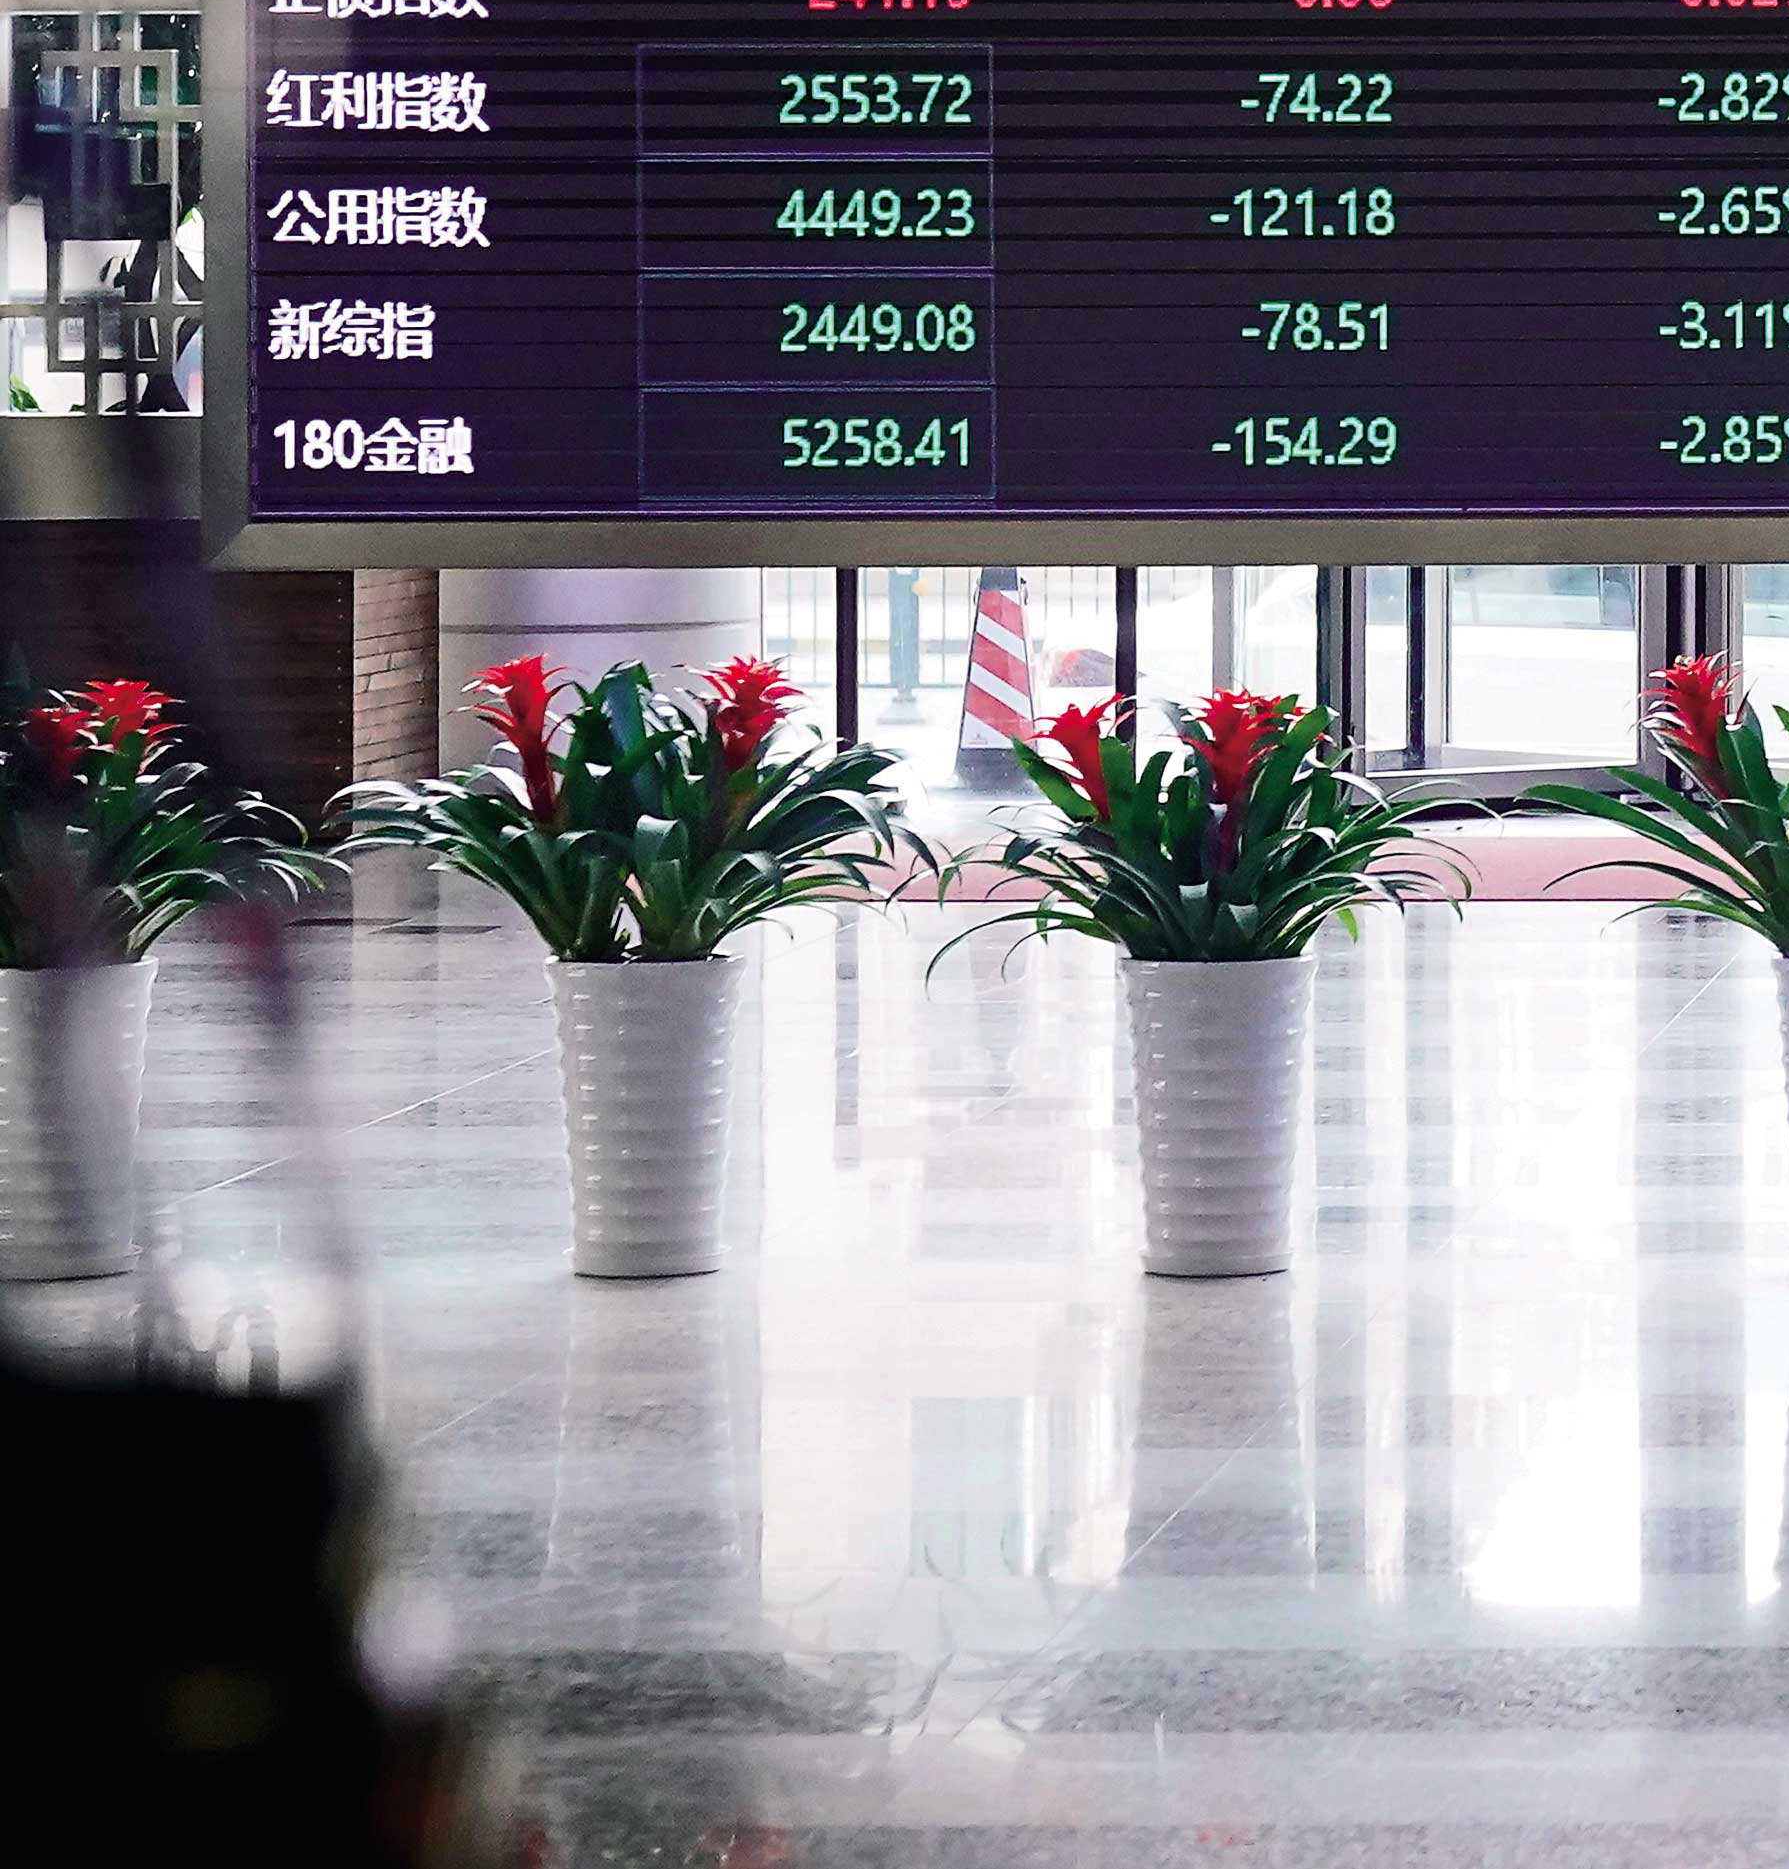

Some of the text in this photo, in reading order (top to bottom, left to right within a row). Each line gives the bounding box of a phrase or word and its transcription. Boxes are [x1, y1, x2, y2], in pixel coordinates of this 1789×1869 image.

[267, 186, 490, 247] 公用指数
[777, 189, 974, 237] 4449.23
[1210, 188, 1394, 236] -121.18
[274, 416, 474, 474] 180金融
[784, 418, 968, 466] 5258.41
[1212, 417, 1396, 465] -154.29
